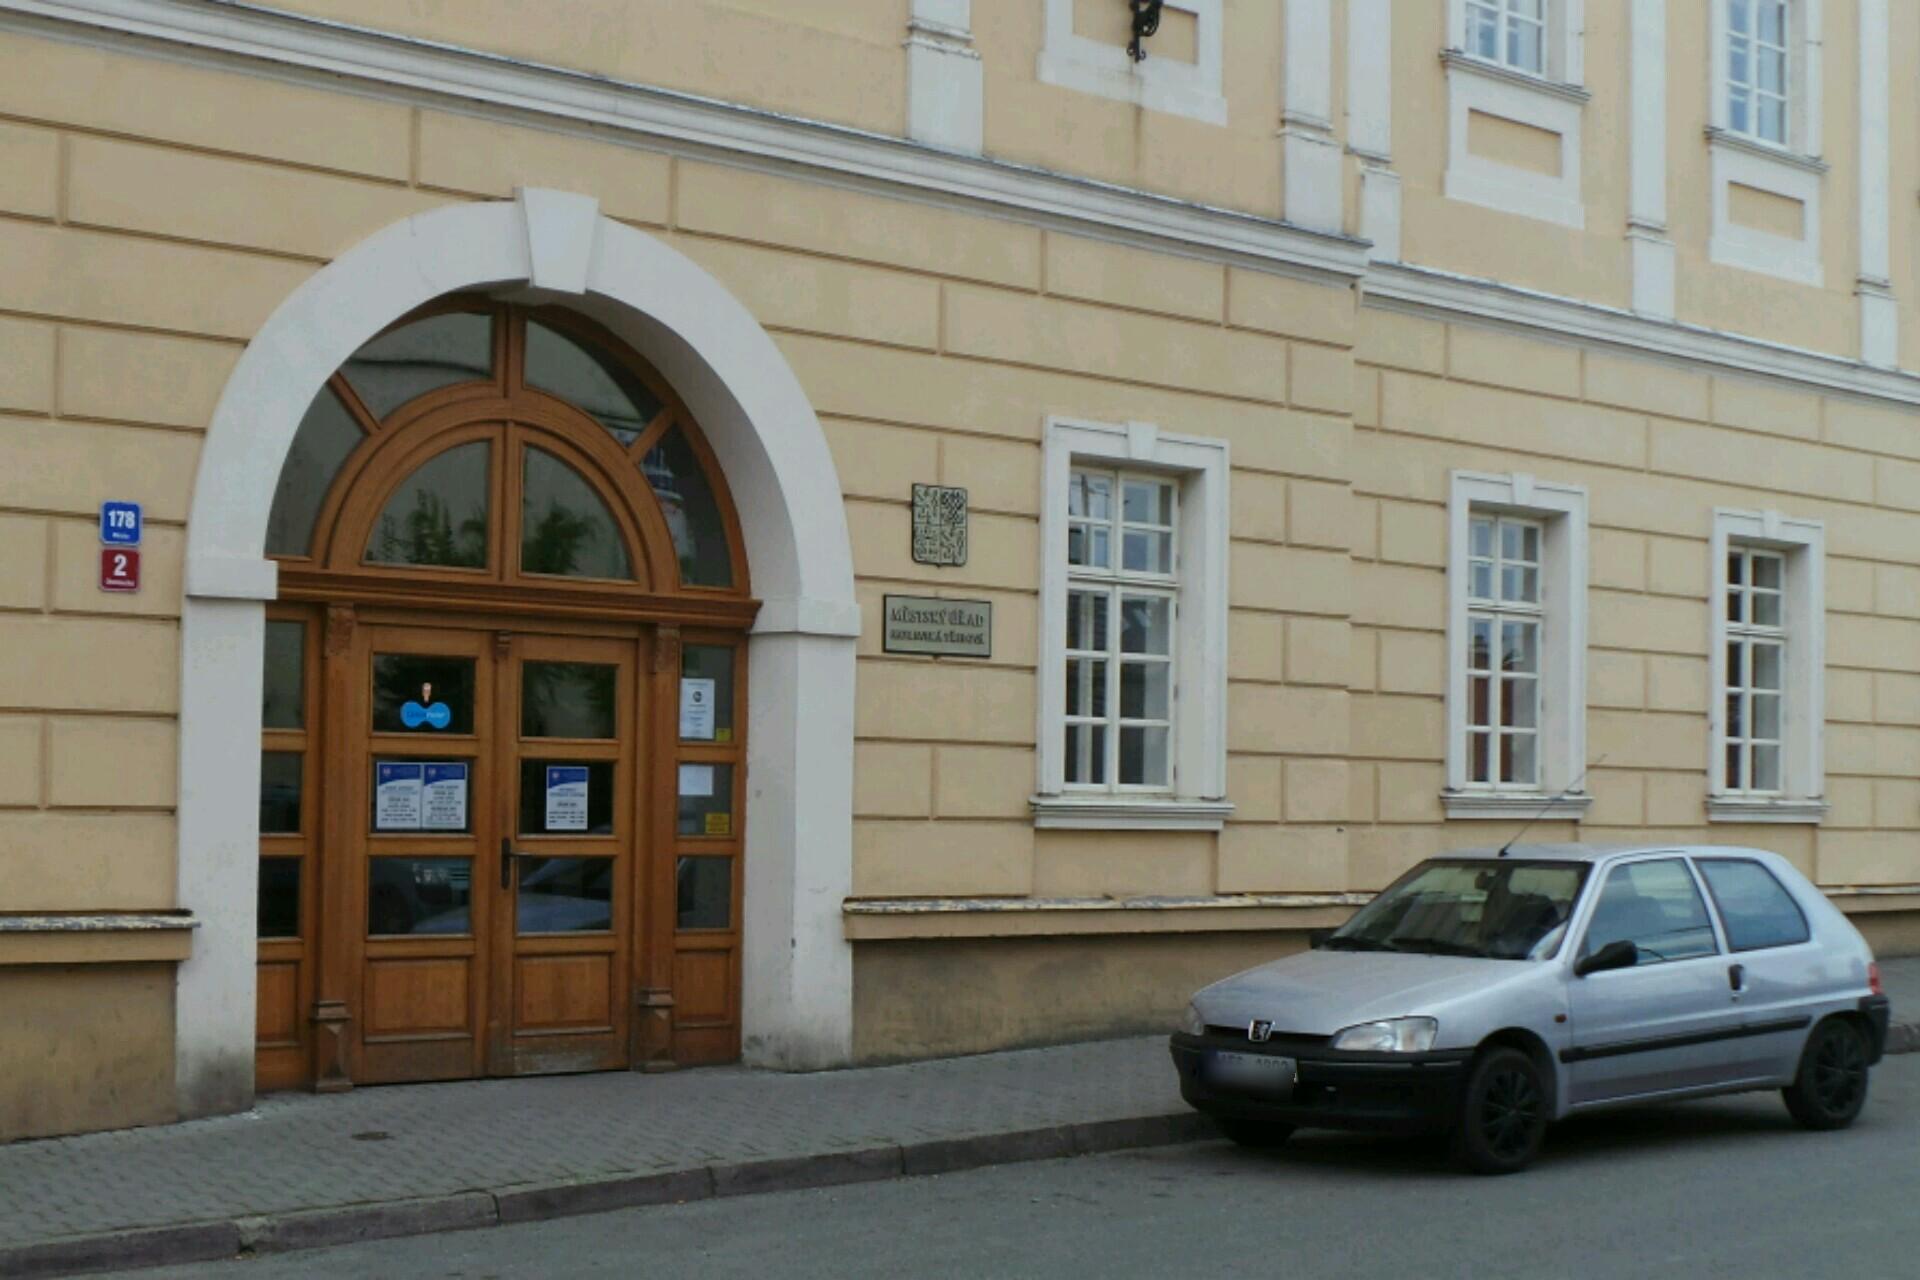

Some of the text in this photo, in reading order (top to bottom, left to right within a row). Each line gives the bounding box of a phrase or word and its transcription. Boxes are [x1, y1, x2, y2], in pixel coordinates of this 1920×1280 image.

[108, 510, 136, 529] 178
[113, 553, 127, 576] 2
[891, 606, 946, 625] MĚSTSKÝ
